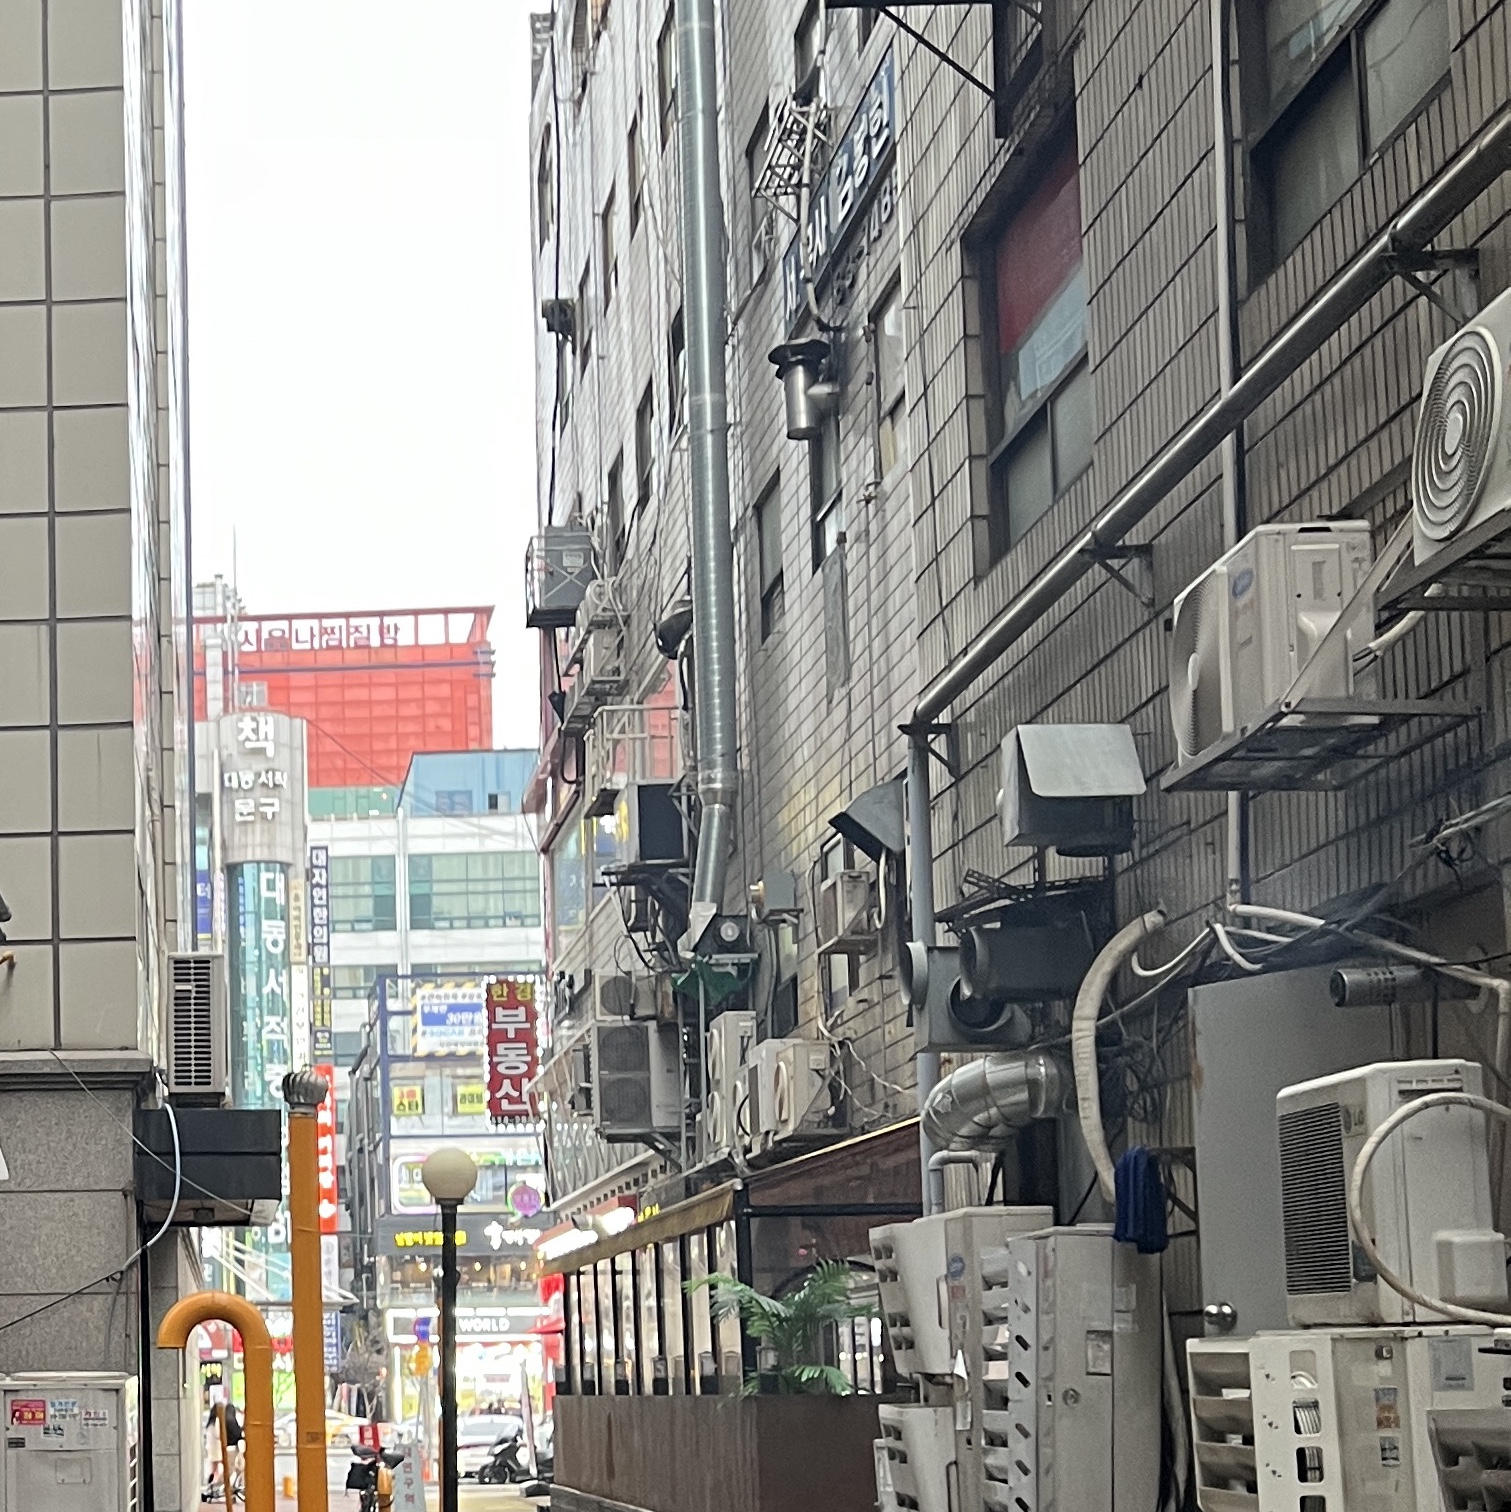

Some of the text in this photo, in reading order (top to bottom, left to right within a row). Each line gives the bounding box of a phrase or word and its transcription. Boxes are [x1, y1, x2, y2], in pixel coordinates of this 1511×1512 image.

[238, 716, 275, 758] 책
[234, 797, 280, 822] 문구
[491, 1006, 532, 1112] 부동산
[458, 1317, 511, 1333] WORLD
